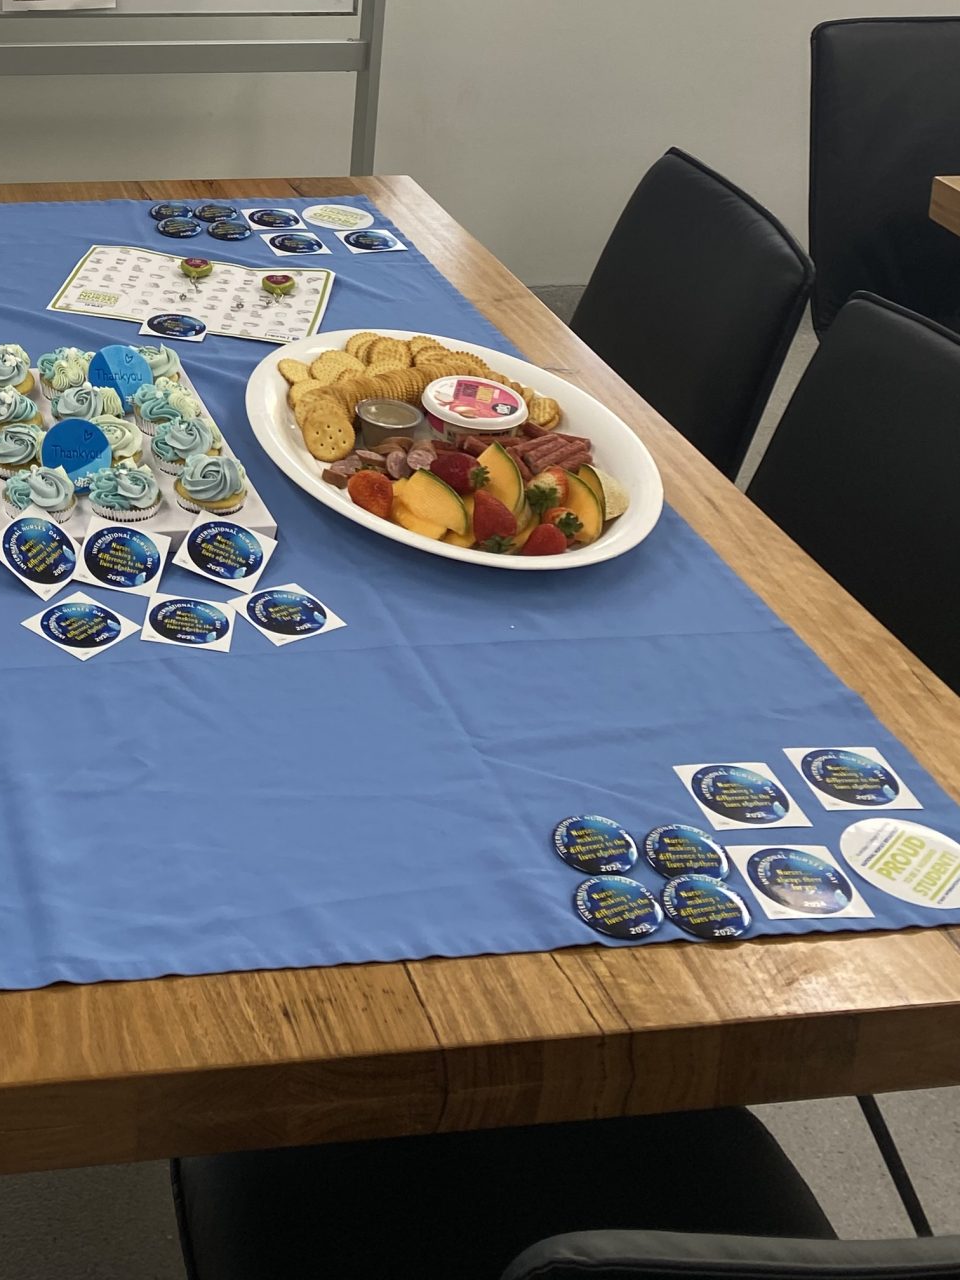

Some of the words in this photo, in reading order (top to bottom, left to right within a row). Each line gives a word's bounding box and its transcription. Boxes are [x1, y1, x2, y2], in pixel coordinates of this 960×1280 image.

[95, 369, 143, 385] Thankyou
[51, 443, 103, 461] Thankyou
[876, 835, 926, 880] PROUD
